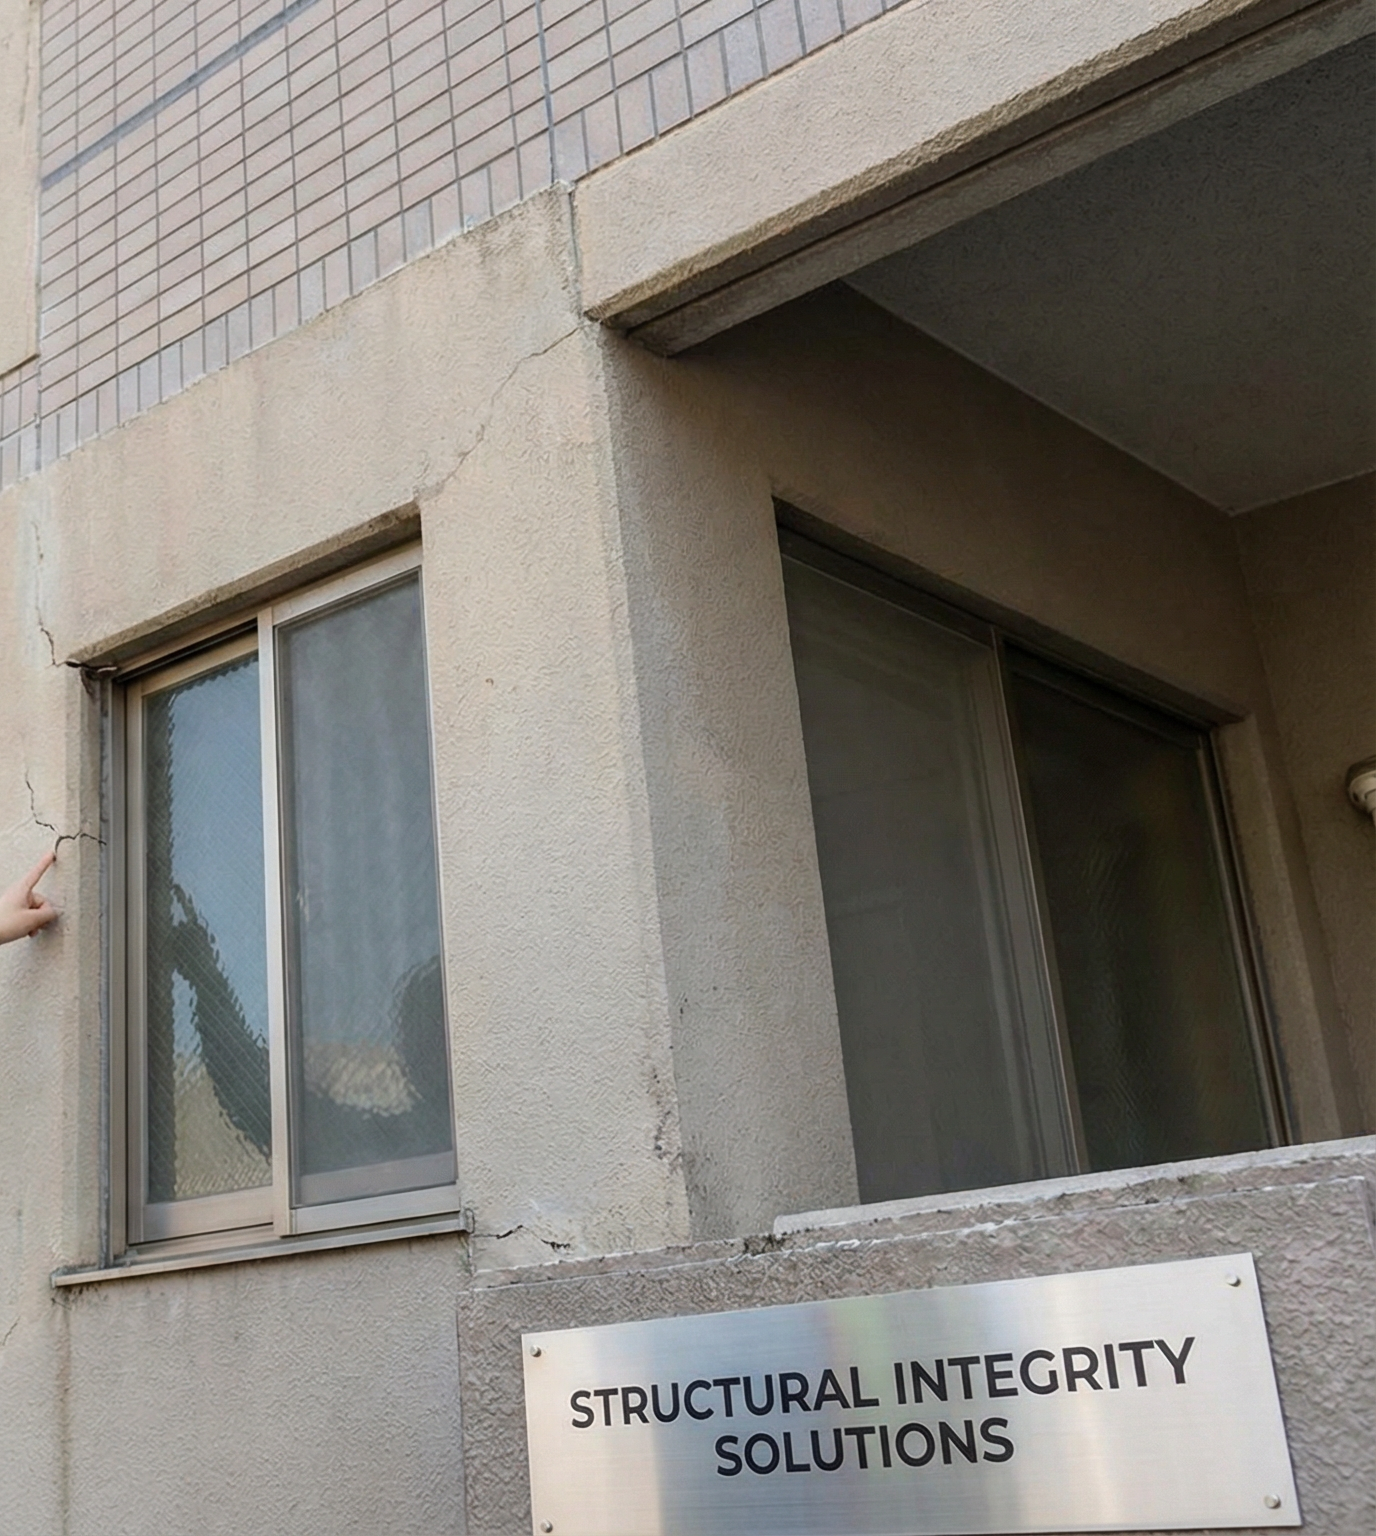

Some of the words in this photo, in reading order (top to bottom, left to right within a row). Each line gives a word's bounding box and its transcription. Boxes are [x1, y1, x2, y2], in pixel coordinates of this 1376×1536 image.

[570, 1366, 880, 1430] STRUCTURAL
[893, 1336, 1196, 1406] INTEGRITY
[714, 1417, 1015, 1477] SOLUTIONS
